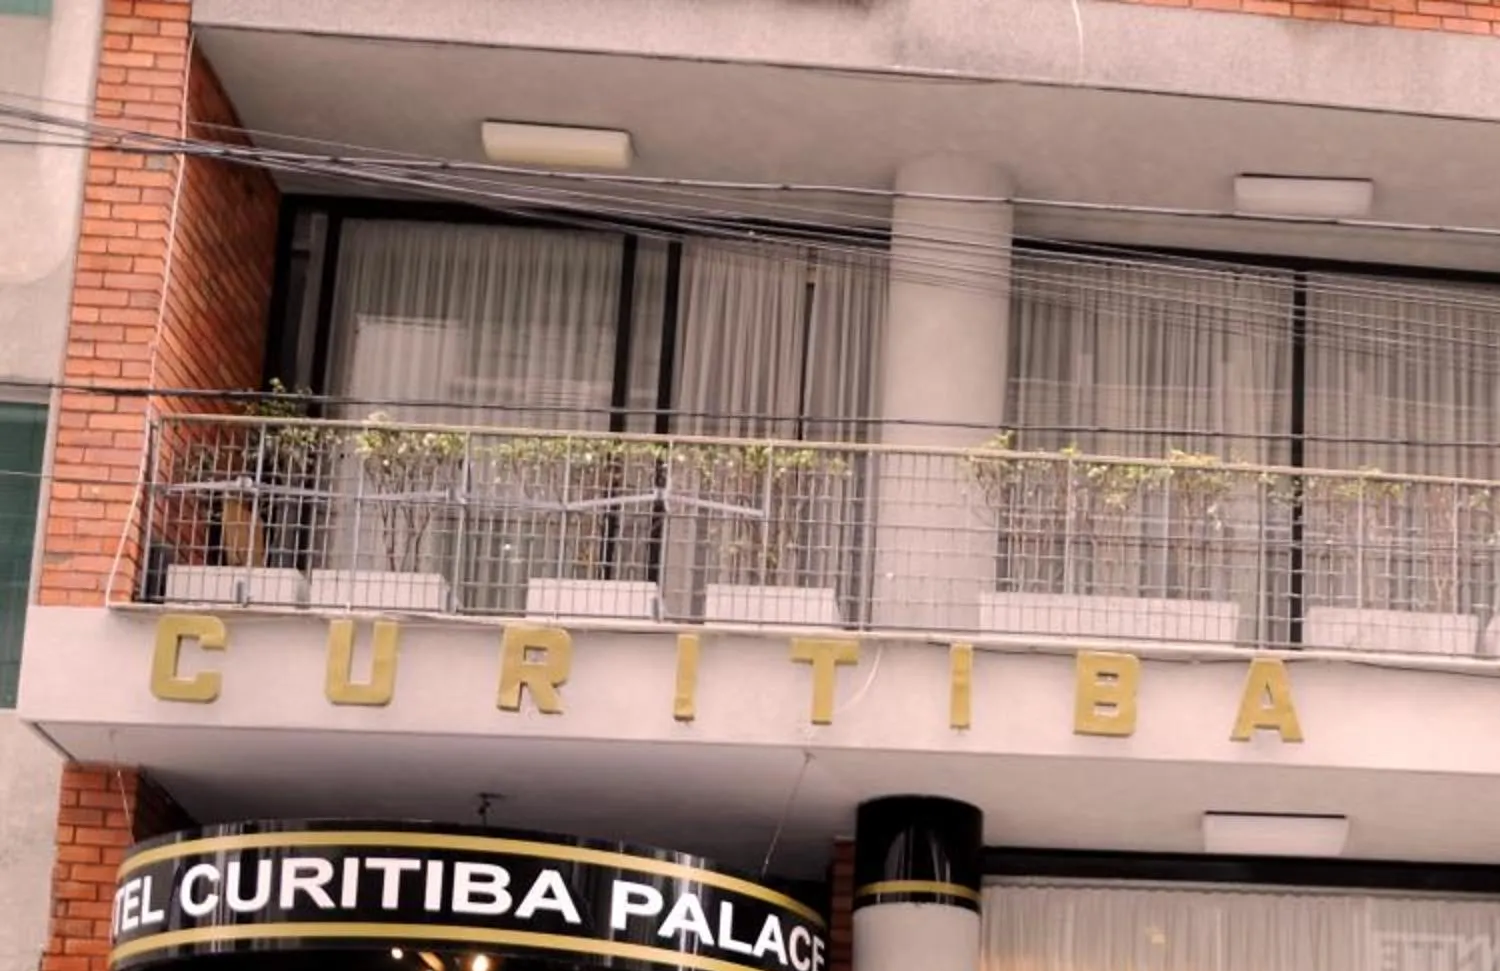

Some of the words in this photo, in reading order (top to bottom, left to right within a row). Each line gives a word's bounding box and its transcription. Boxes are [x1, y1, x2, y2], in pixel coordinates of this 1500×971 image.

[150, 614, 1304, 742] CURITIBA
[110, 874, 165, 938] TEL
[179, 856, 581, 924] CURITIBA
